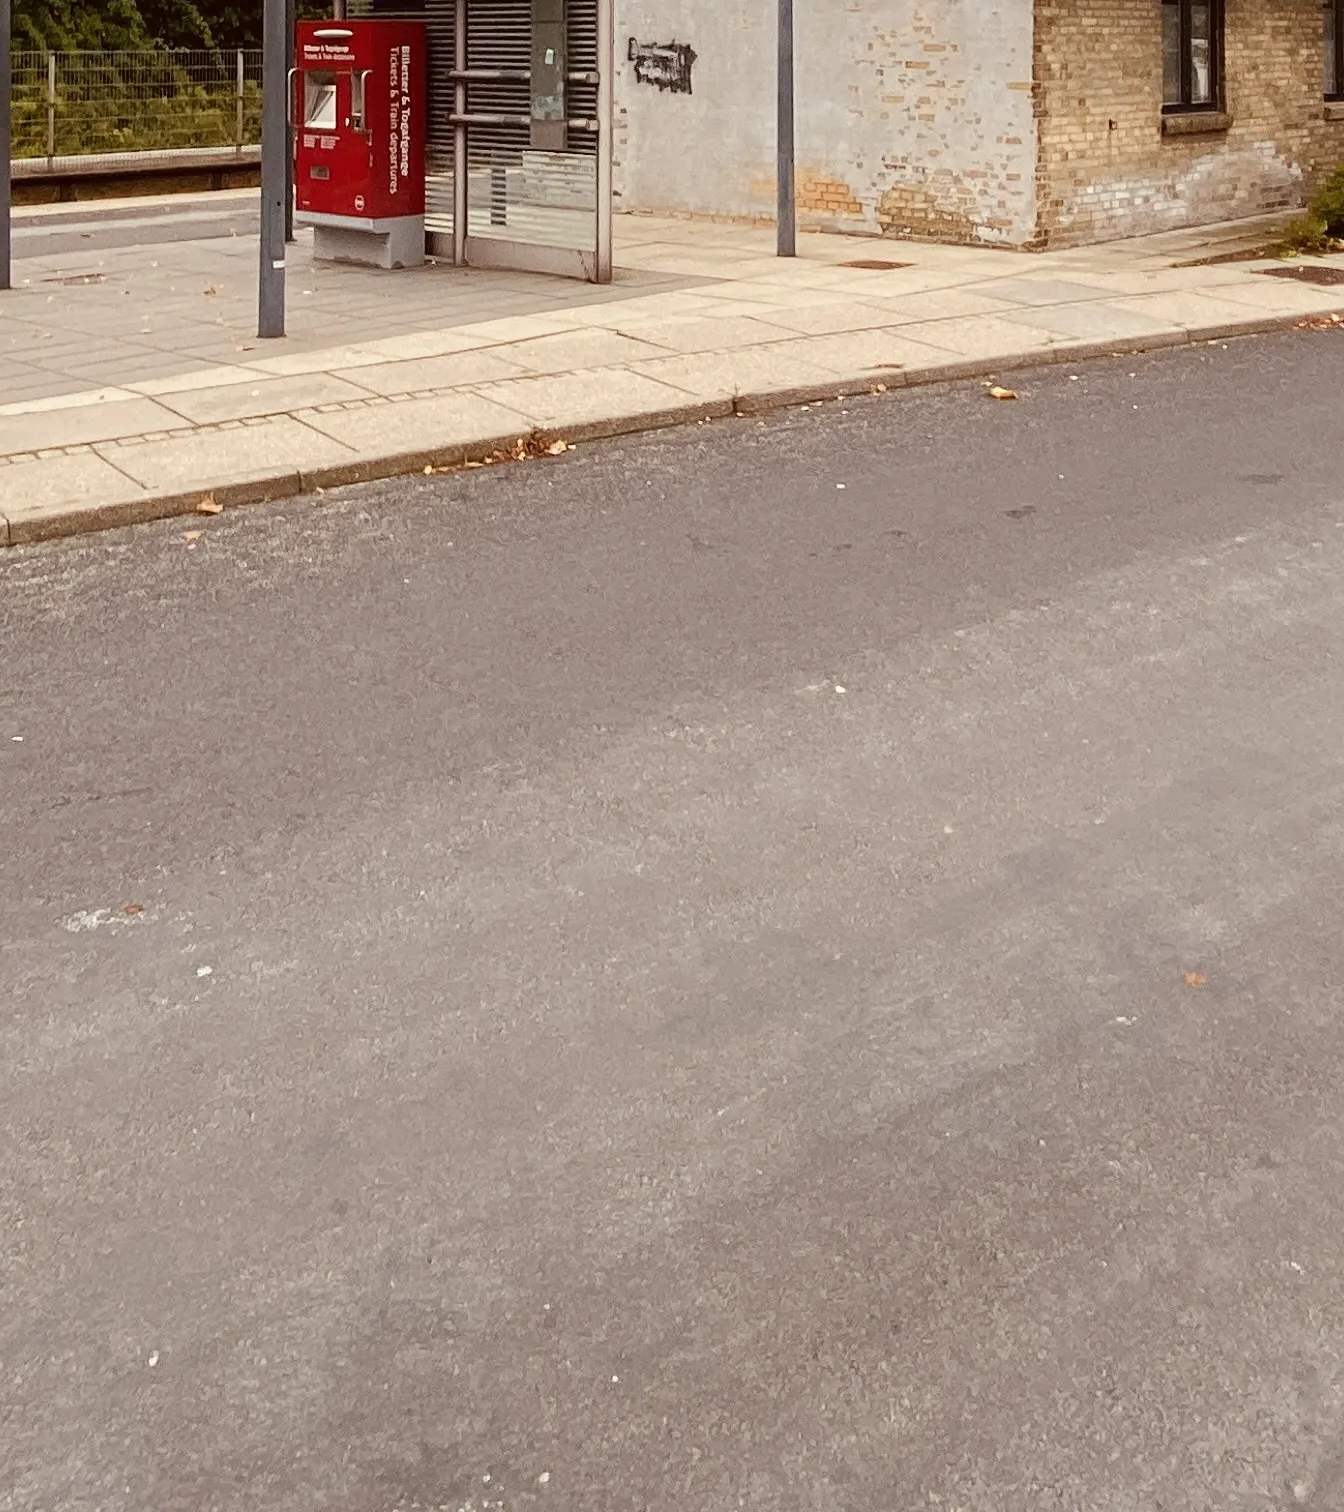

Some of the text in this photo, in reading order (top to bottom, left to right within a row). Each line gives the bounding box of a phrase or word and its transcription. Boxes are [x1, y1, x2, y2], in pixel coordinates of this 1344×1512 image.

[388, 46, 399, 194] Tickets & Train departures
[401, 95, 410, 105] &
